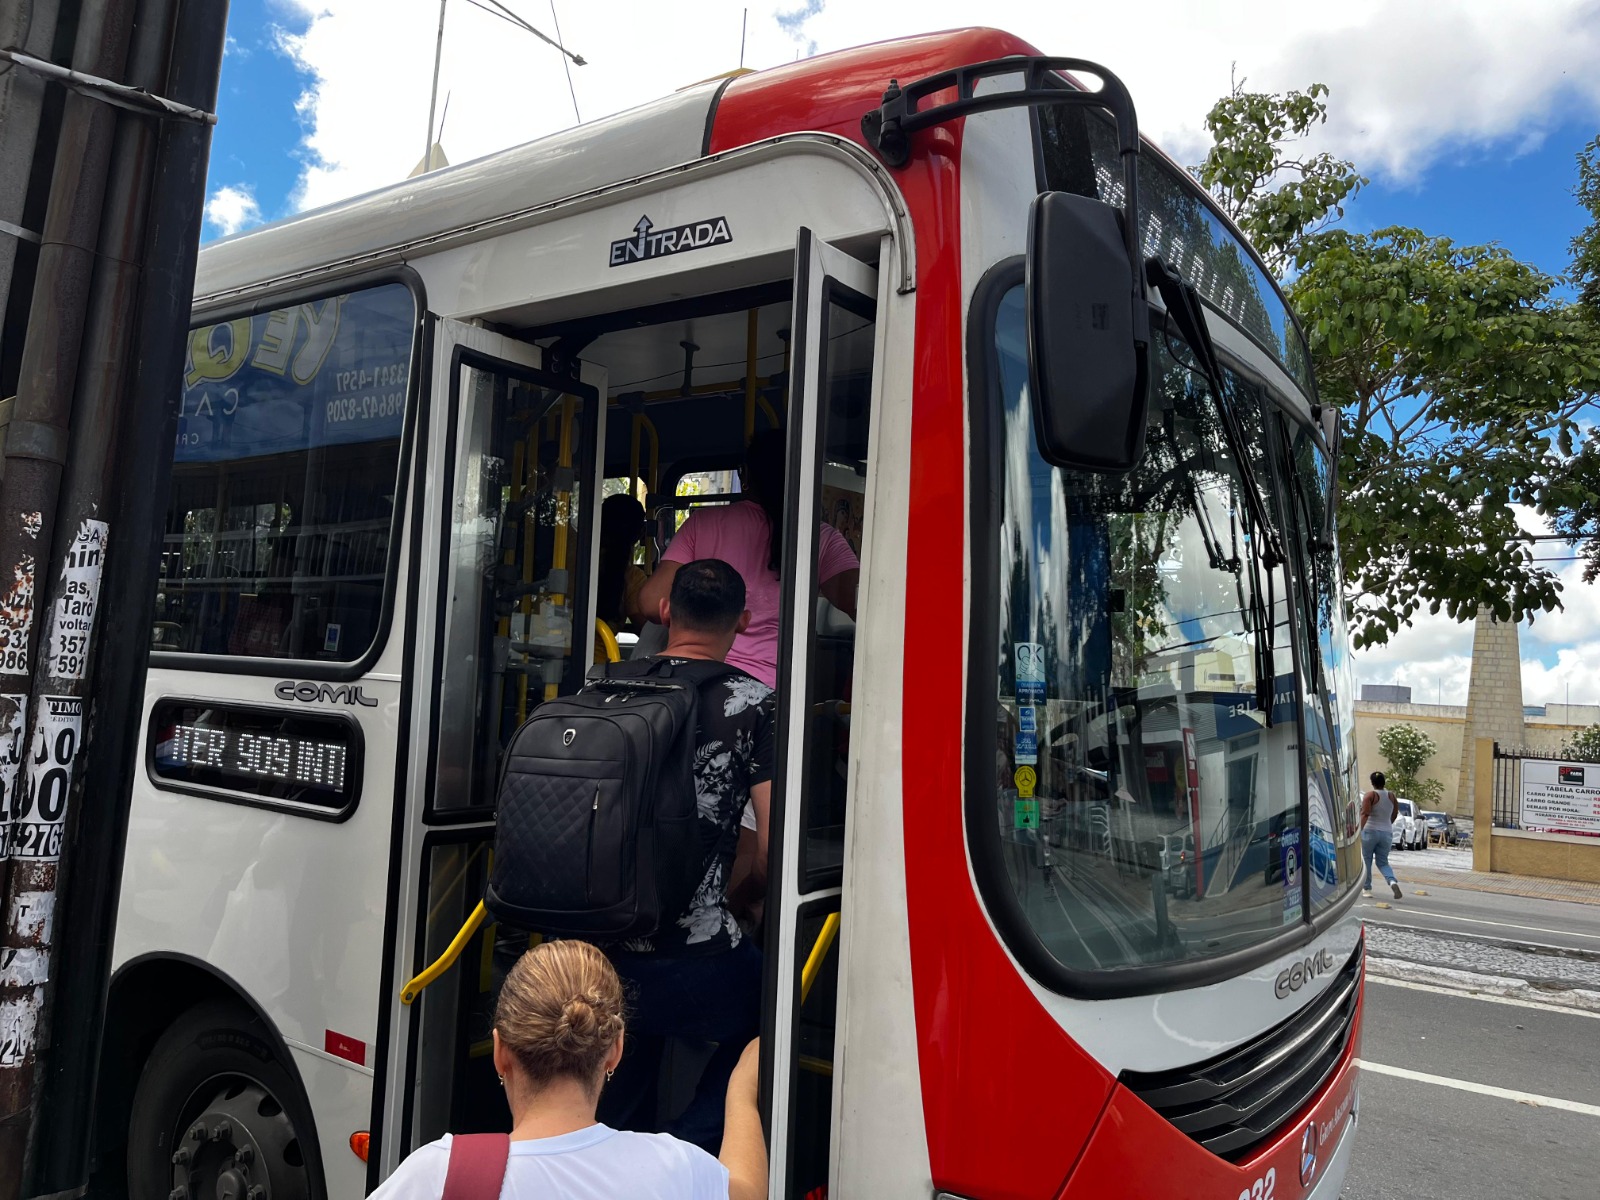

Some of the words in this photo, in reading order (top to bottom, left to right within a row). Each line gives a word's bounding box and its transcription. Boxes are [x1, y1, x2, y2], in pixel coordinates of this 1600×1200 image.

[611, 220, 730, 265] ENTRADA
[274, 680, 378, 707] COMIL
[236, 732, 291, 778] 909
[1275, 948, 1333, 999] COMIL
